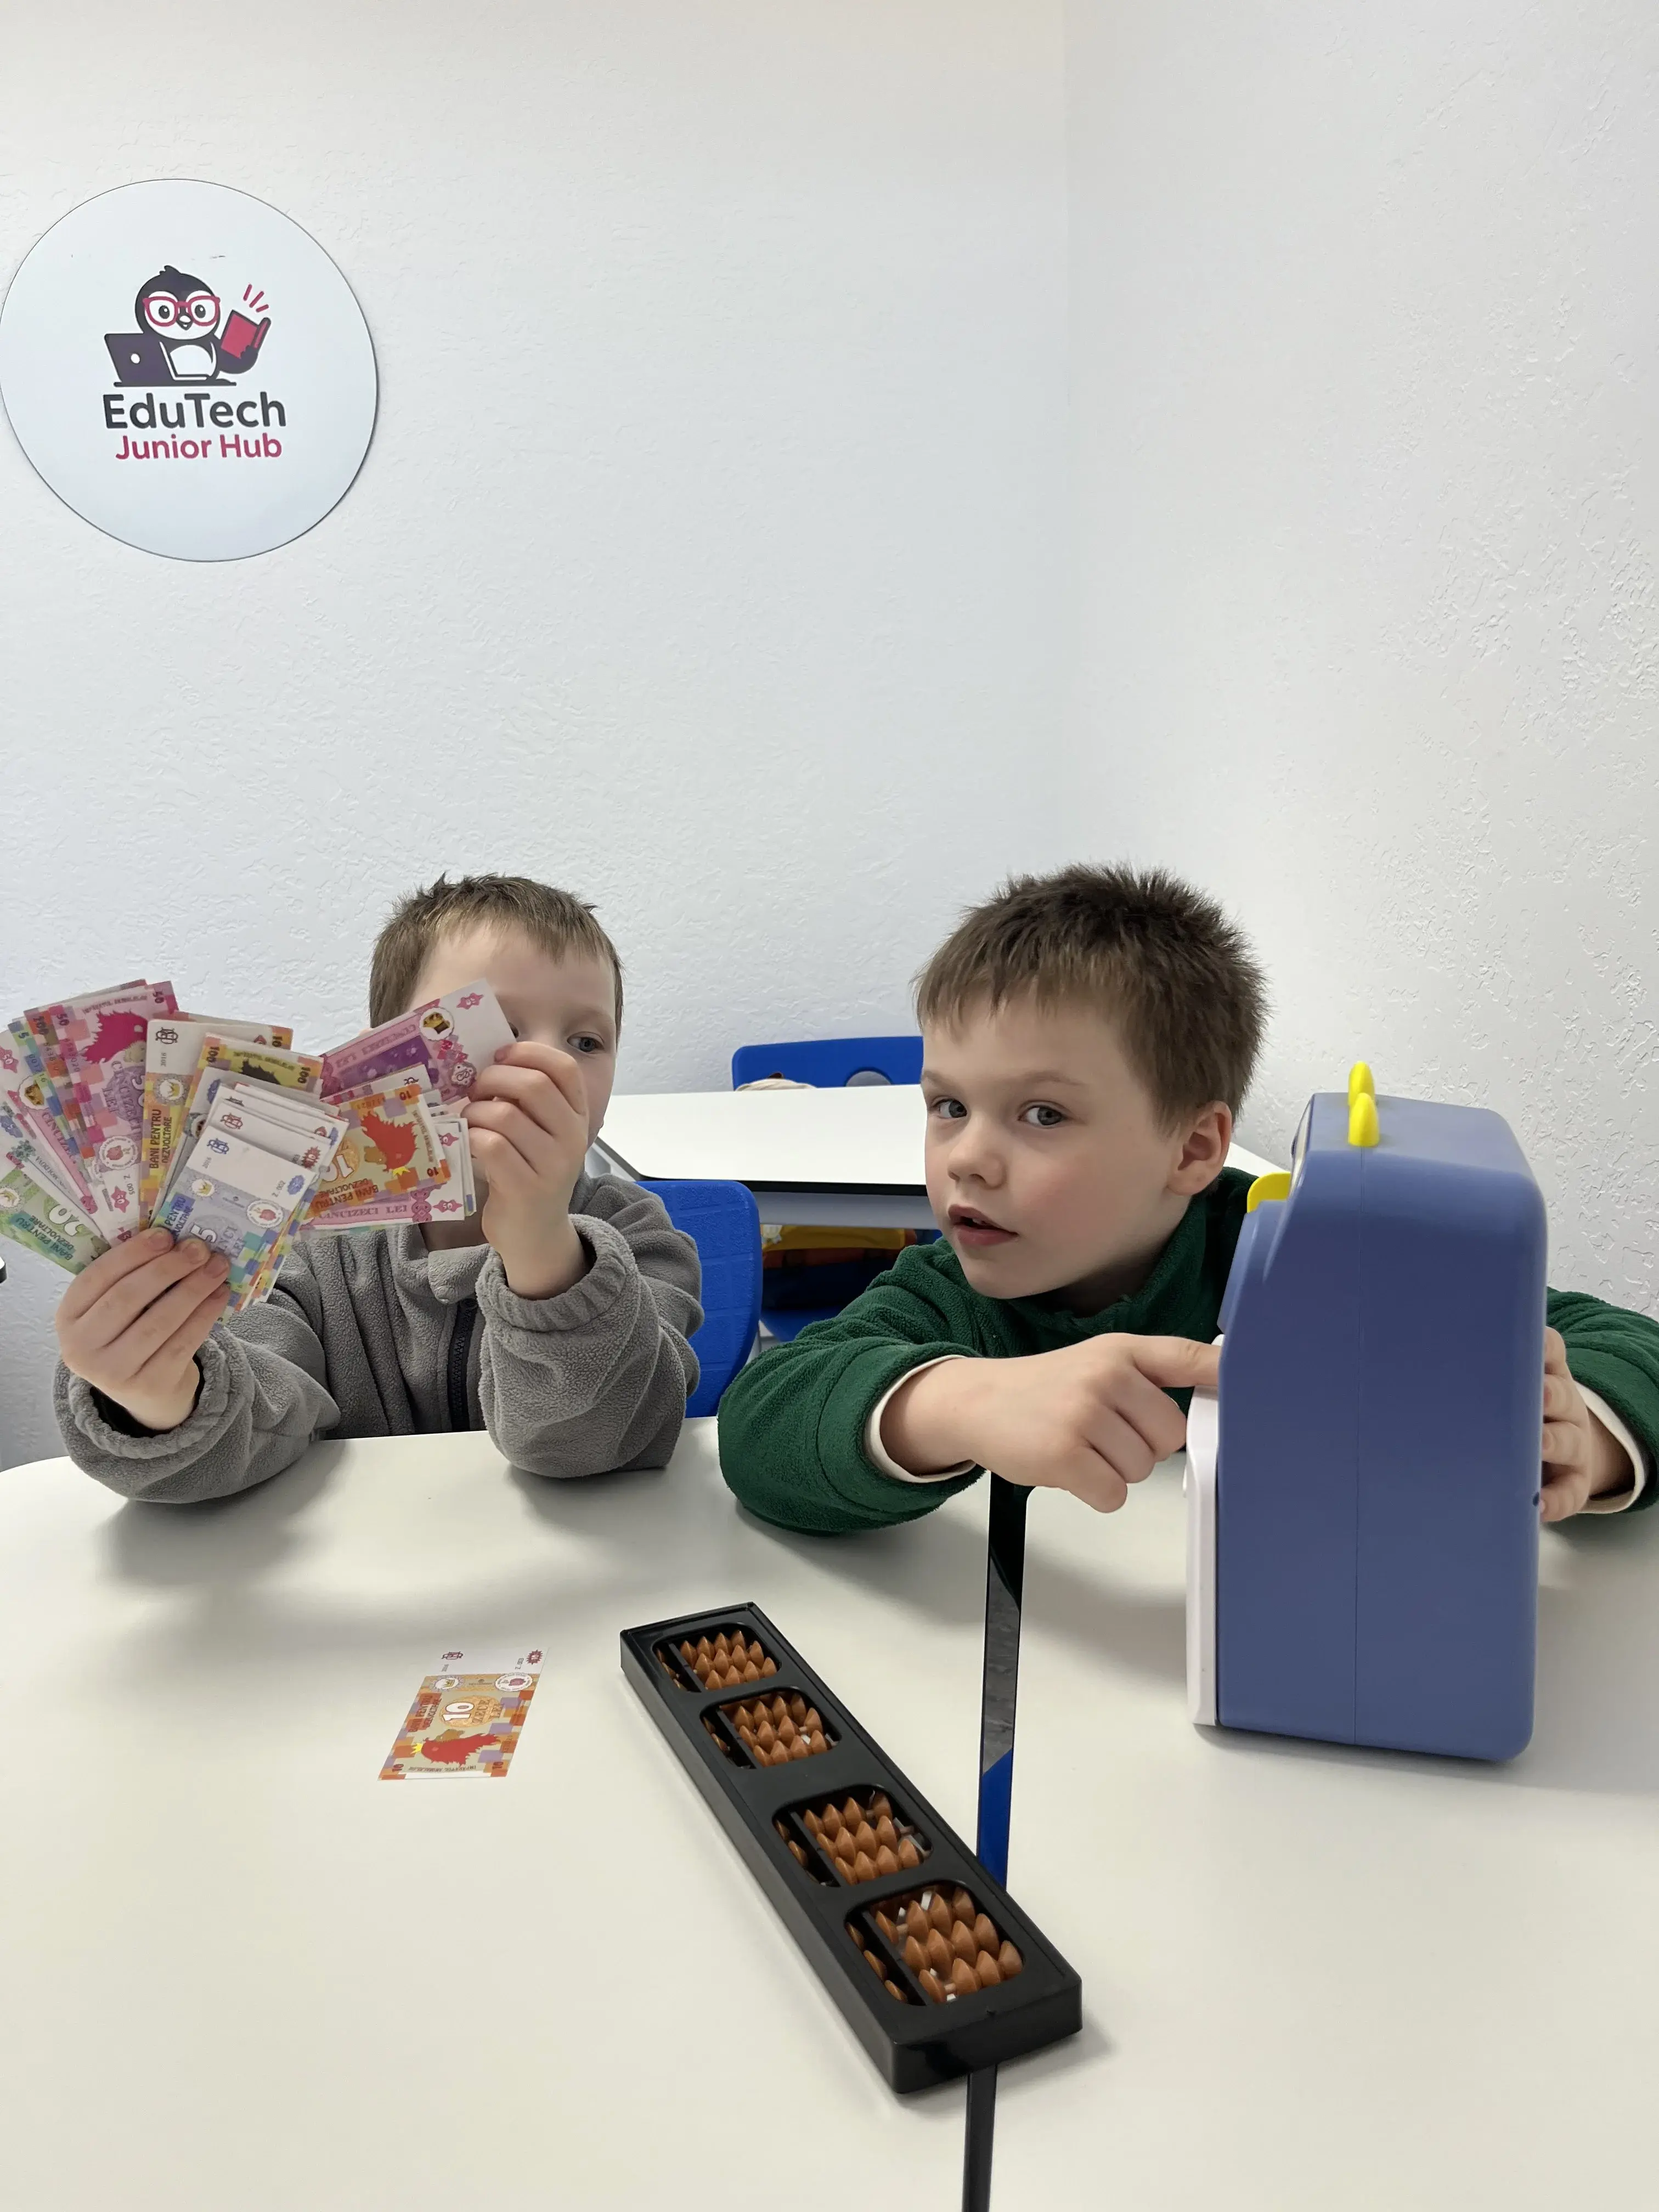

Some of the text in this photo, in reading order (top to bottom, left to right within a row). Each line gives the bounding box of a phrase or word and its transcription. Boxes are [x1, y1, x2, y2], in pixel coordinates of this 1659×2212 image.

[103, 391, 287, 429] EduTech
[115, 432, 283, 460] Junior Hub
[57, 1013, 70, 1026] 50
[399, 1090, 412, 1101] 10
[149, 1109, 162, 1169] BANI PENTRU
[15, 1217, 74, 1261] BANI PENTRU
[442, 1701, 475, 1722] 10
